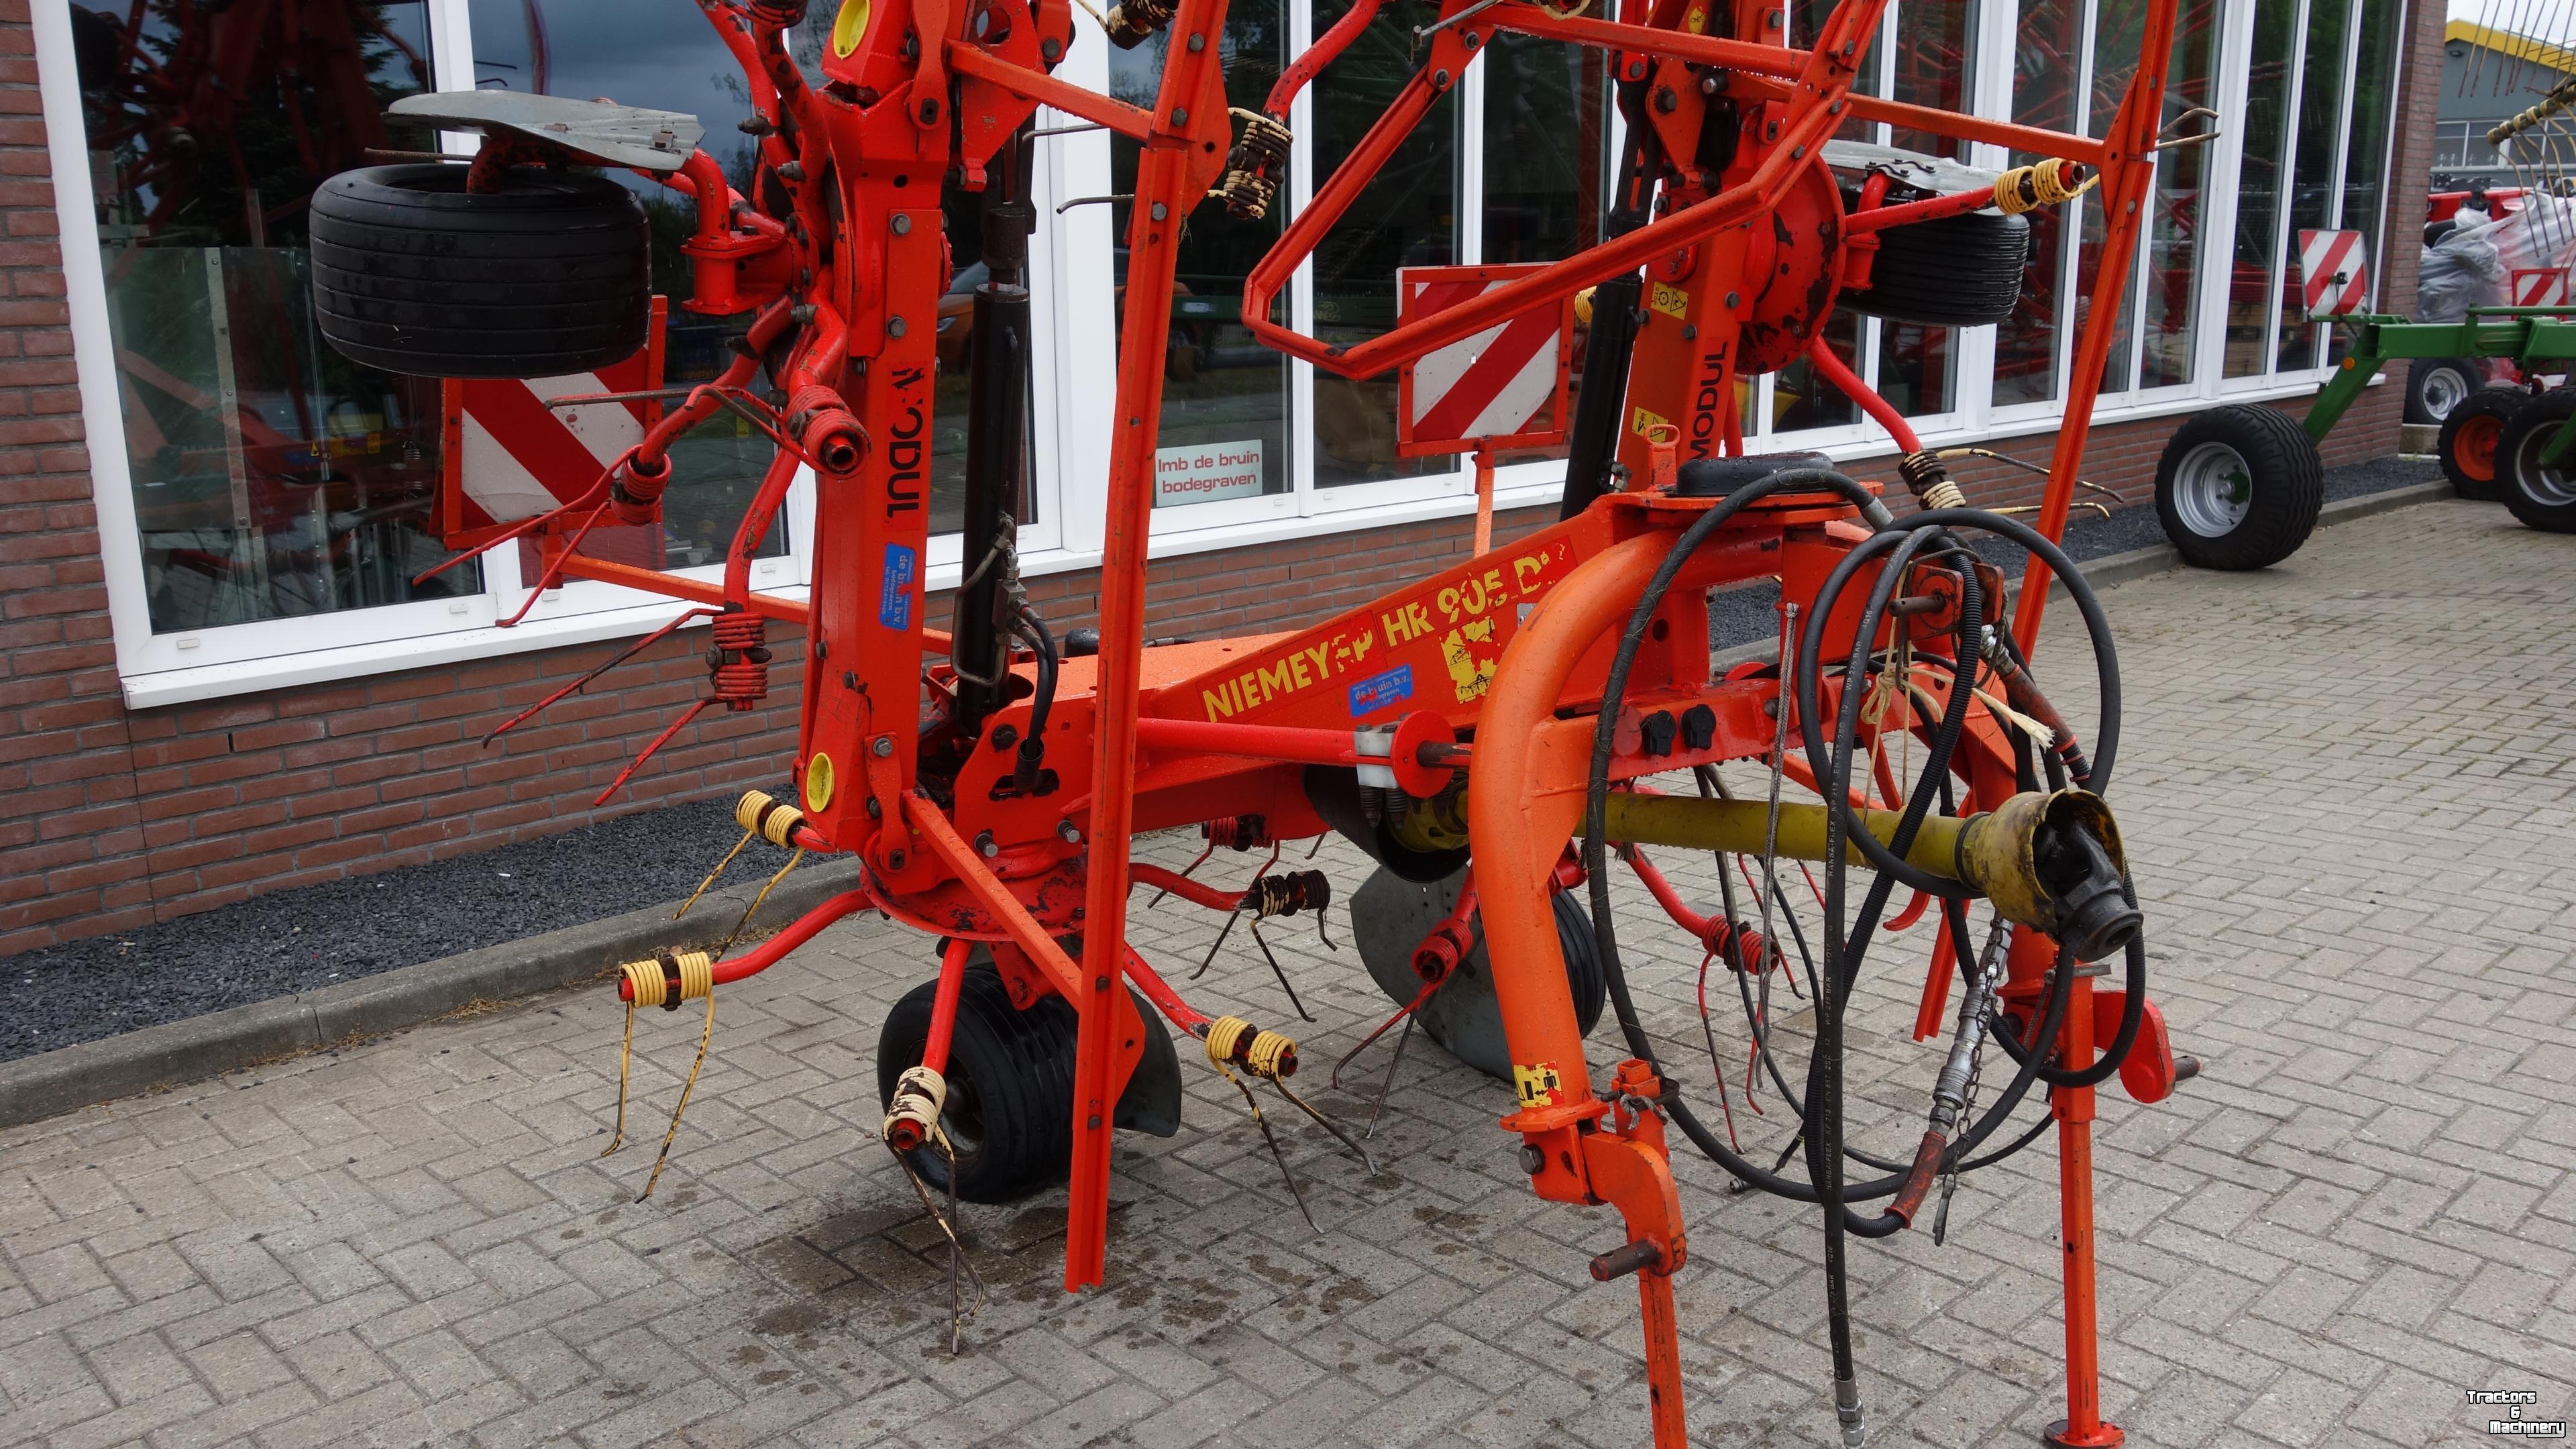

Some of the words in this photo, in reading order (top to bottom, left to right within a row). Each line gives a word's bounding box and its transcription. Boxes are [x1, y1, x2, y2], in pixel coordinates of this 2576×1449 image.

[1194, 455, 1214, 469] de
[1219, 451, 1260, 466] bruin
[1162, 474, 1256, 494] bodegraven
[899, 555, 908, 569] de
[1381, 602, 1435, 647] HR
[1437, 568, 1507, 624] 905
[1845, 678, 1853, 690] WP
[1849, 661, 1857, 675] 275
[1853, 640, 1862, 658] BAR
